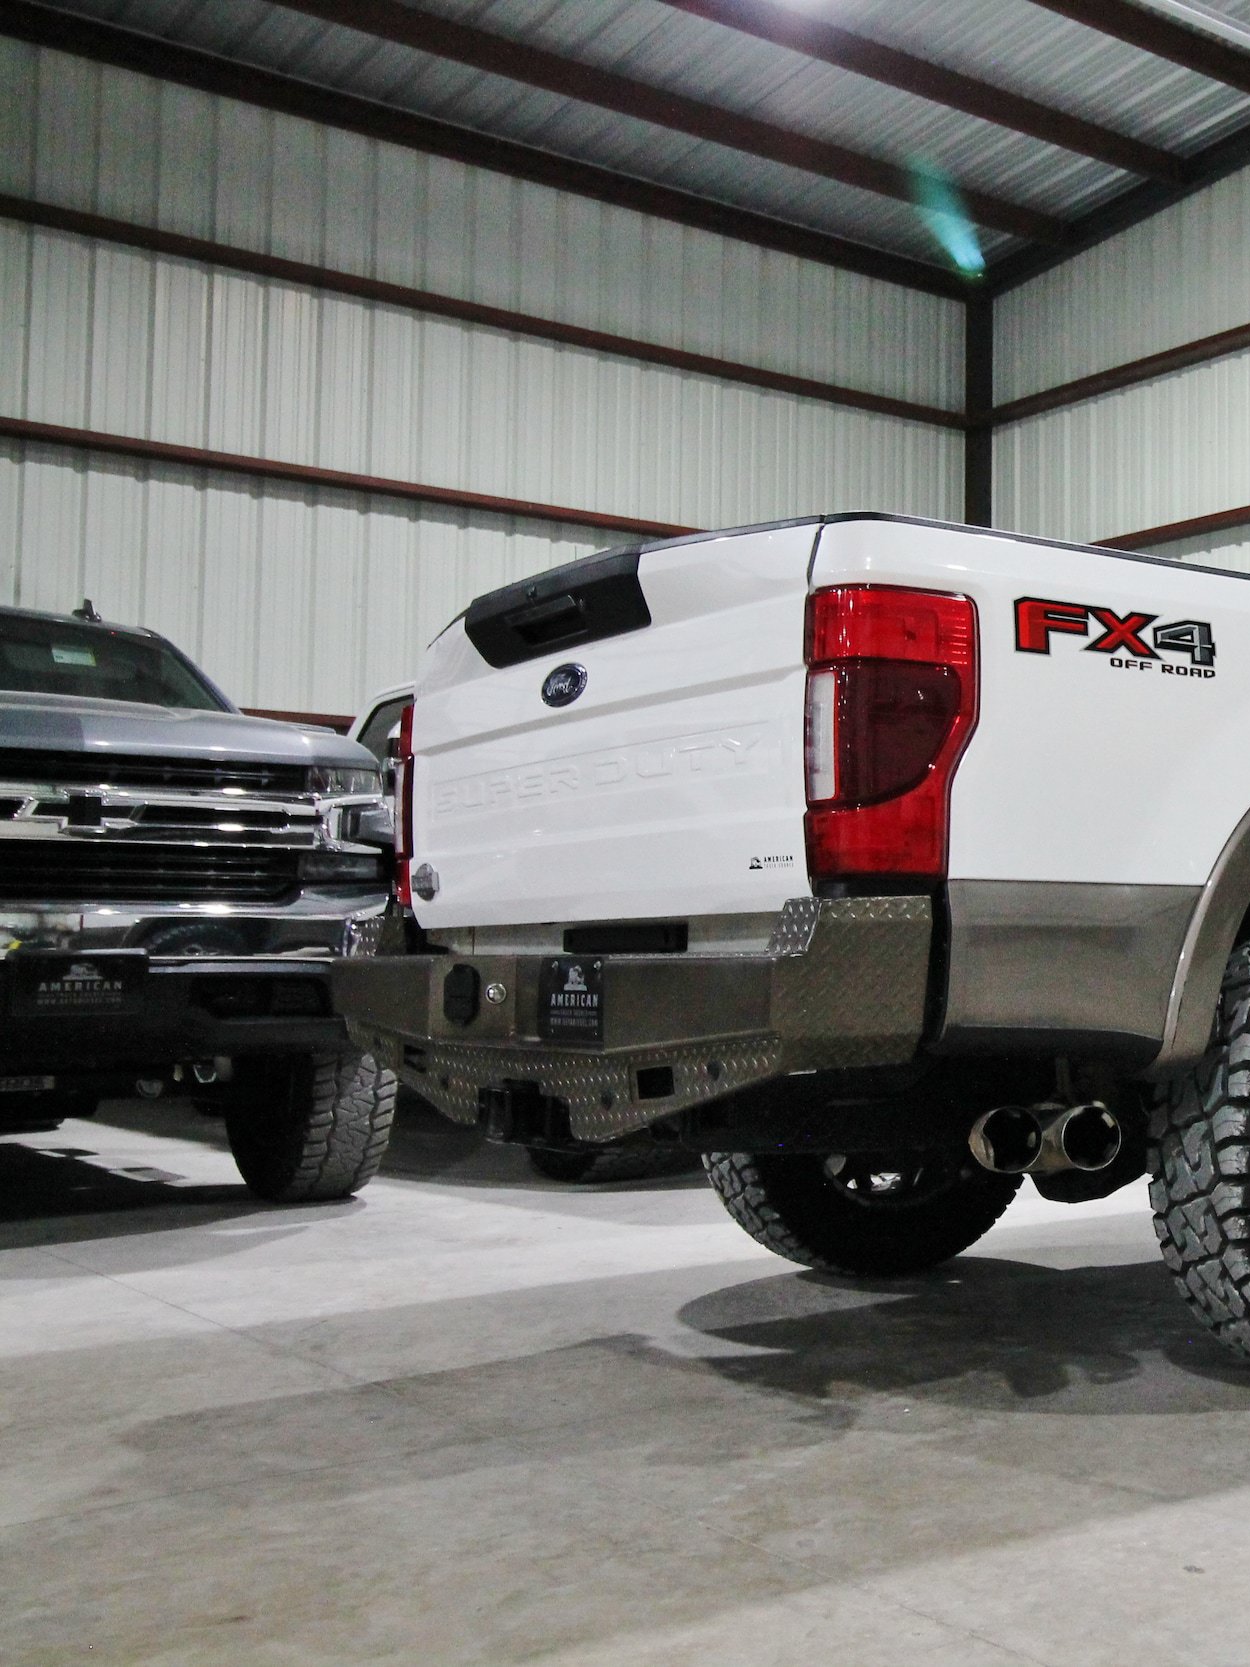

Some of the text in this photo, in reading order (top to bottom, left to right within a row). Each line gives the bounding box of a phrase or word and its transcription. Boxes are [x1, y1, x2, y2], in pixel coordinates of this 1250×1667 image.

[1013, 596, 1216, 667] FX4
[1109, 656, 1216, 679] OFF ROAD
[433, 735, 763, 814] SUPER DUTY
[764, 855, 793, 863] AMERICAN
[39, 981, 122, 992] AMERICAN
[550, 993, 599, 1008] AMERICAN
